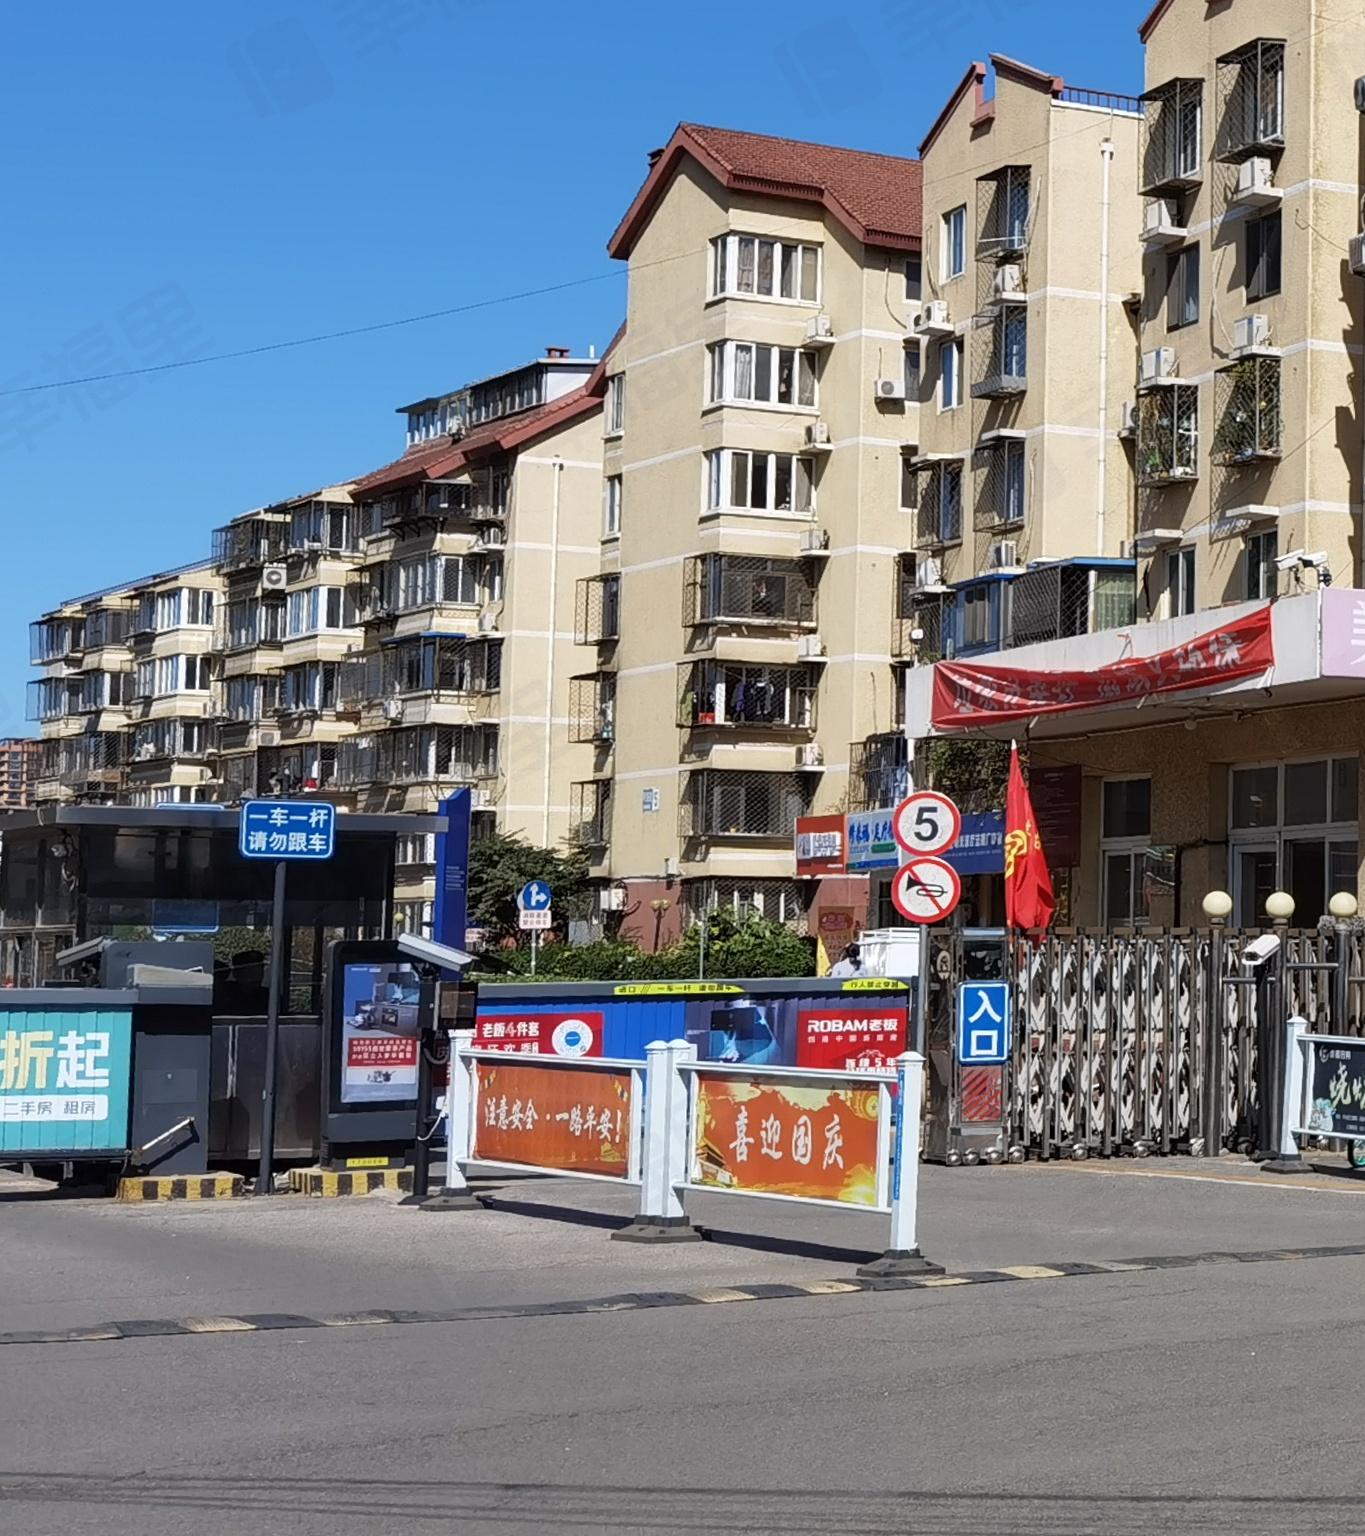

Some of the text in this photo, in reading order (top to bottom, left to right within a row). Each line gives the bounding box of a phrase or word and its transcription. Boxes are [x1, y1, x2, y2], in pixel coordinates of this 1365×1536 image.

[249, 807, 329, 829] 一车一杆
[914, 806, 939, 842] 5
[248, 830, 328, 853] 请勿跟车
[967, 988, 1003, 1058] 入口
[0, 1030, 110, 1089] 折起
[3, 1100, 97, 1116] 二手房 租房
[729, 1105, 845, 1170] 喜迎国庆
